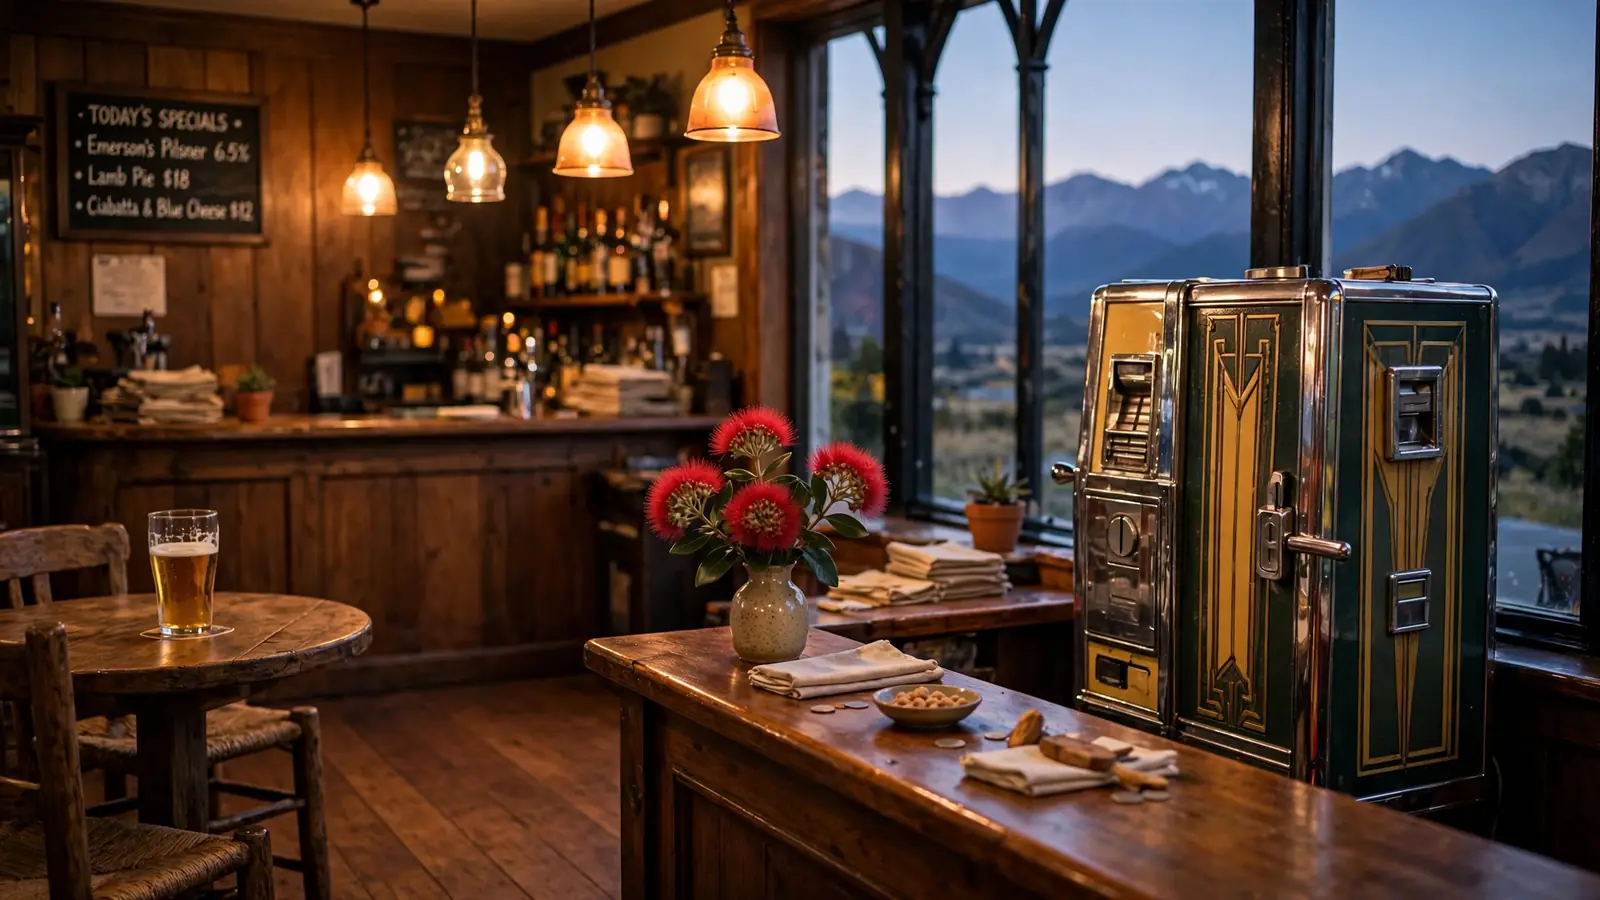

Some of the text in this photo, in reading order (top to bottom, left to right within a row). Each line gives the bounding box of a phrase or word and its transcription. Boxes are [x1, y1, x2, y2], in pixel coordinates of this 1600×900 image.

[88, 104, 228, 133] TODAY'S SPECIALS
[87, 133, 250, 163] Emerson's Pilsner 6.5%
[88, 164, 191, 190] Lamb Pie $18
[156, 197, 183, 219] Blue
[229, 201, 254, 222] $12
